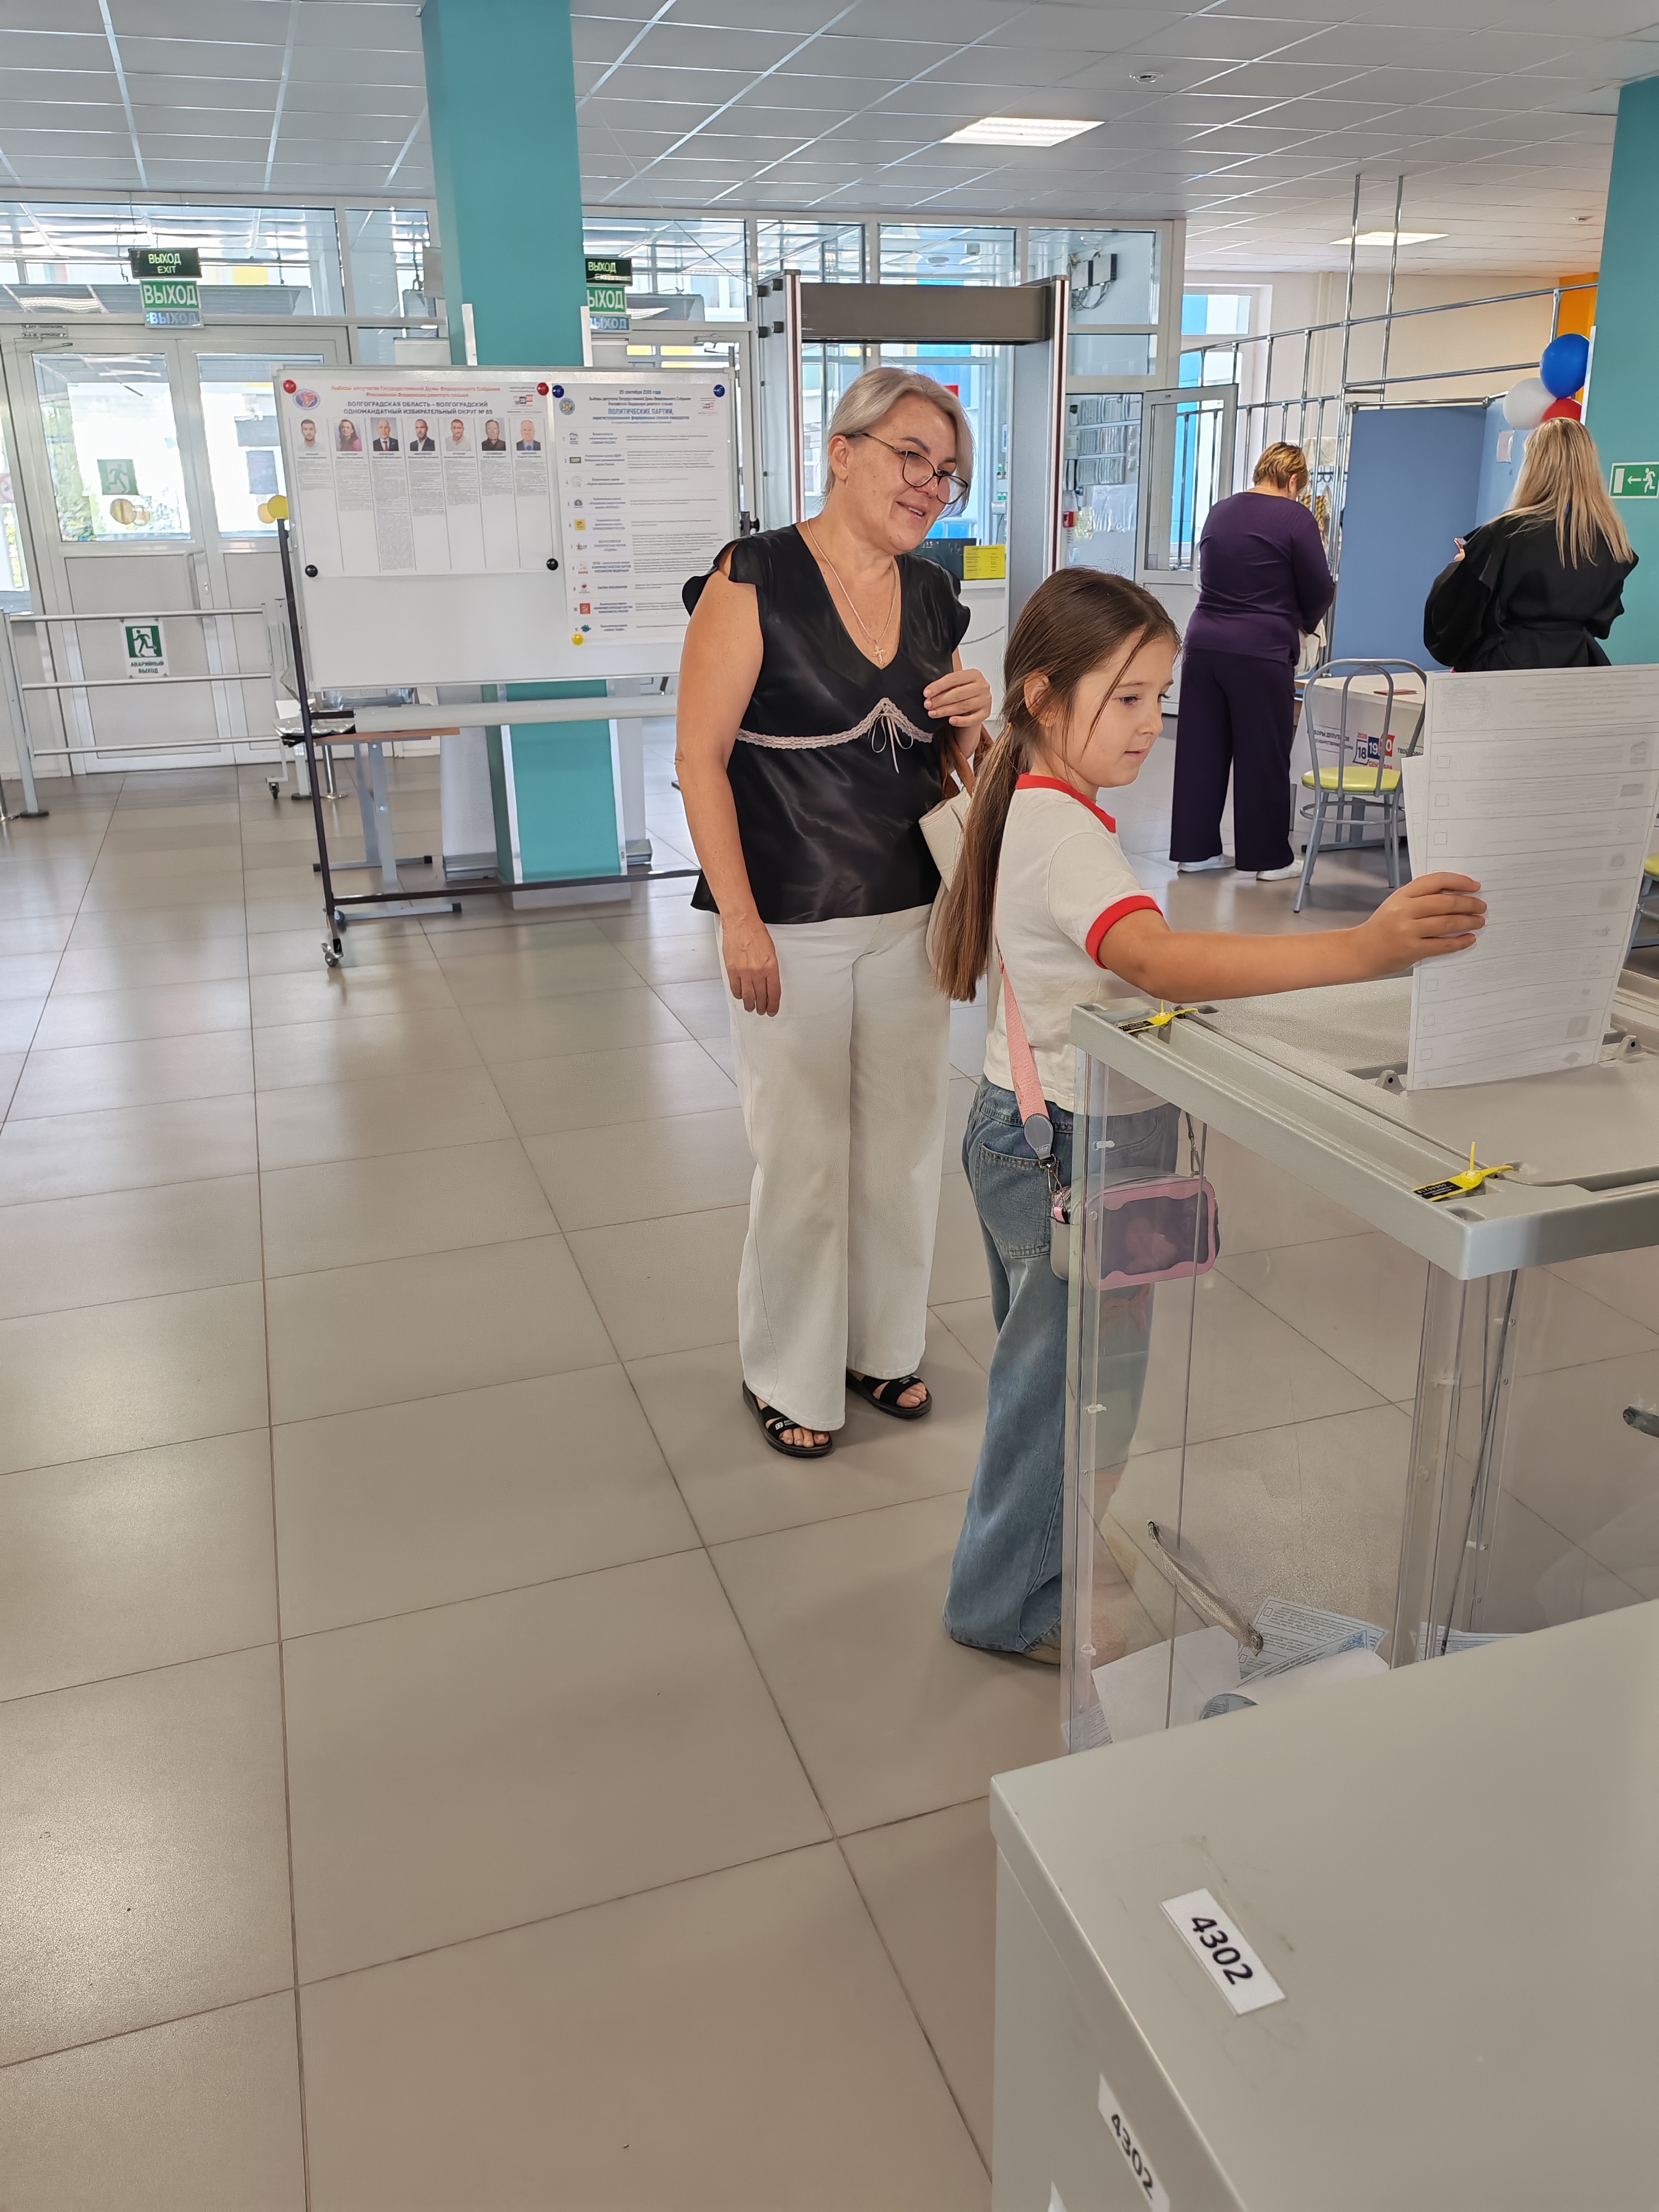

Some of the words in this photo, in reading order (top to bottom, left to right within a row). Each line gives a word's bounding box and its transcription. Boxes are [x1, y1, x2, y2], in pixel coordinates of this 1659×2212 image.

[148, 253, 181, 265] ВЫХОД
[588, 262, 617, 273] ВЫХОД
[157, 266, 176, 274] EXIT
[143, 285, 197, 305] ВЫХОД
[587, 290, 624, 309] ЫХОД
[149, 312, 199, 325] ВЫХОД
[1358, 746, 1366, 759] 18
[1369, 741, 1378, 755] 19
[1191, 1917, 1253, 1985] 4302
[1111, 2113, 1153, 2200] 4302
